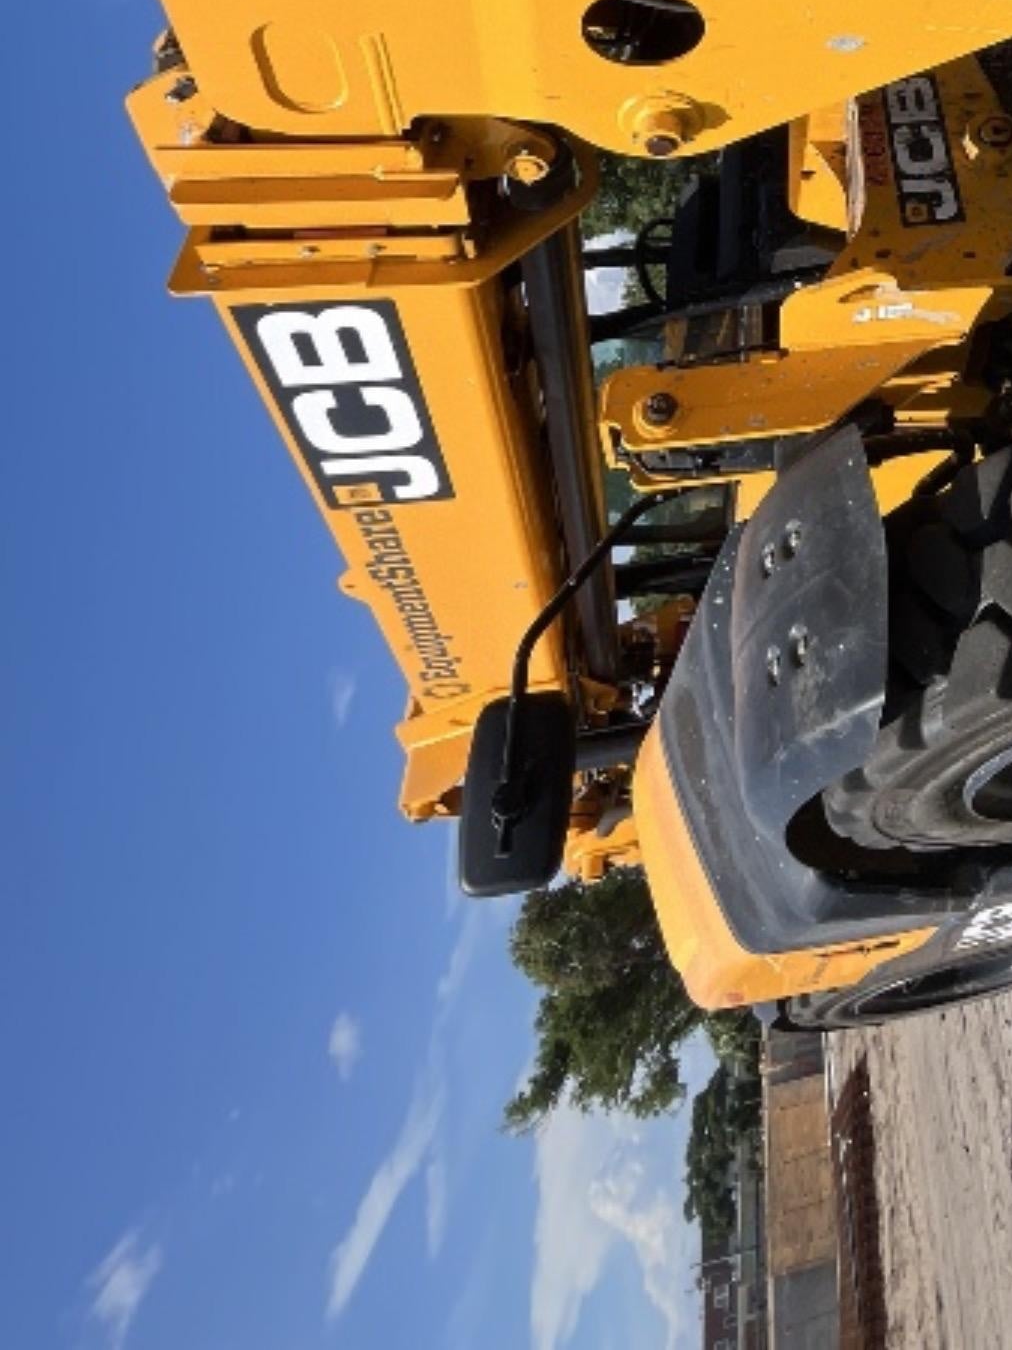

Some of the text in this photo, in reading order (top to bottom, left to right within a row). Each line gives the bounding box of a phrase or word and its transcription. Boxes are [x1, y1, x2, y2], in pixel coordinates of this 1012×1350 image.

[886, 76, 959, 222] JCB
[256, 304, 440, 500] JCB
[355, 507, 460, 684] EquipmentShare
